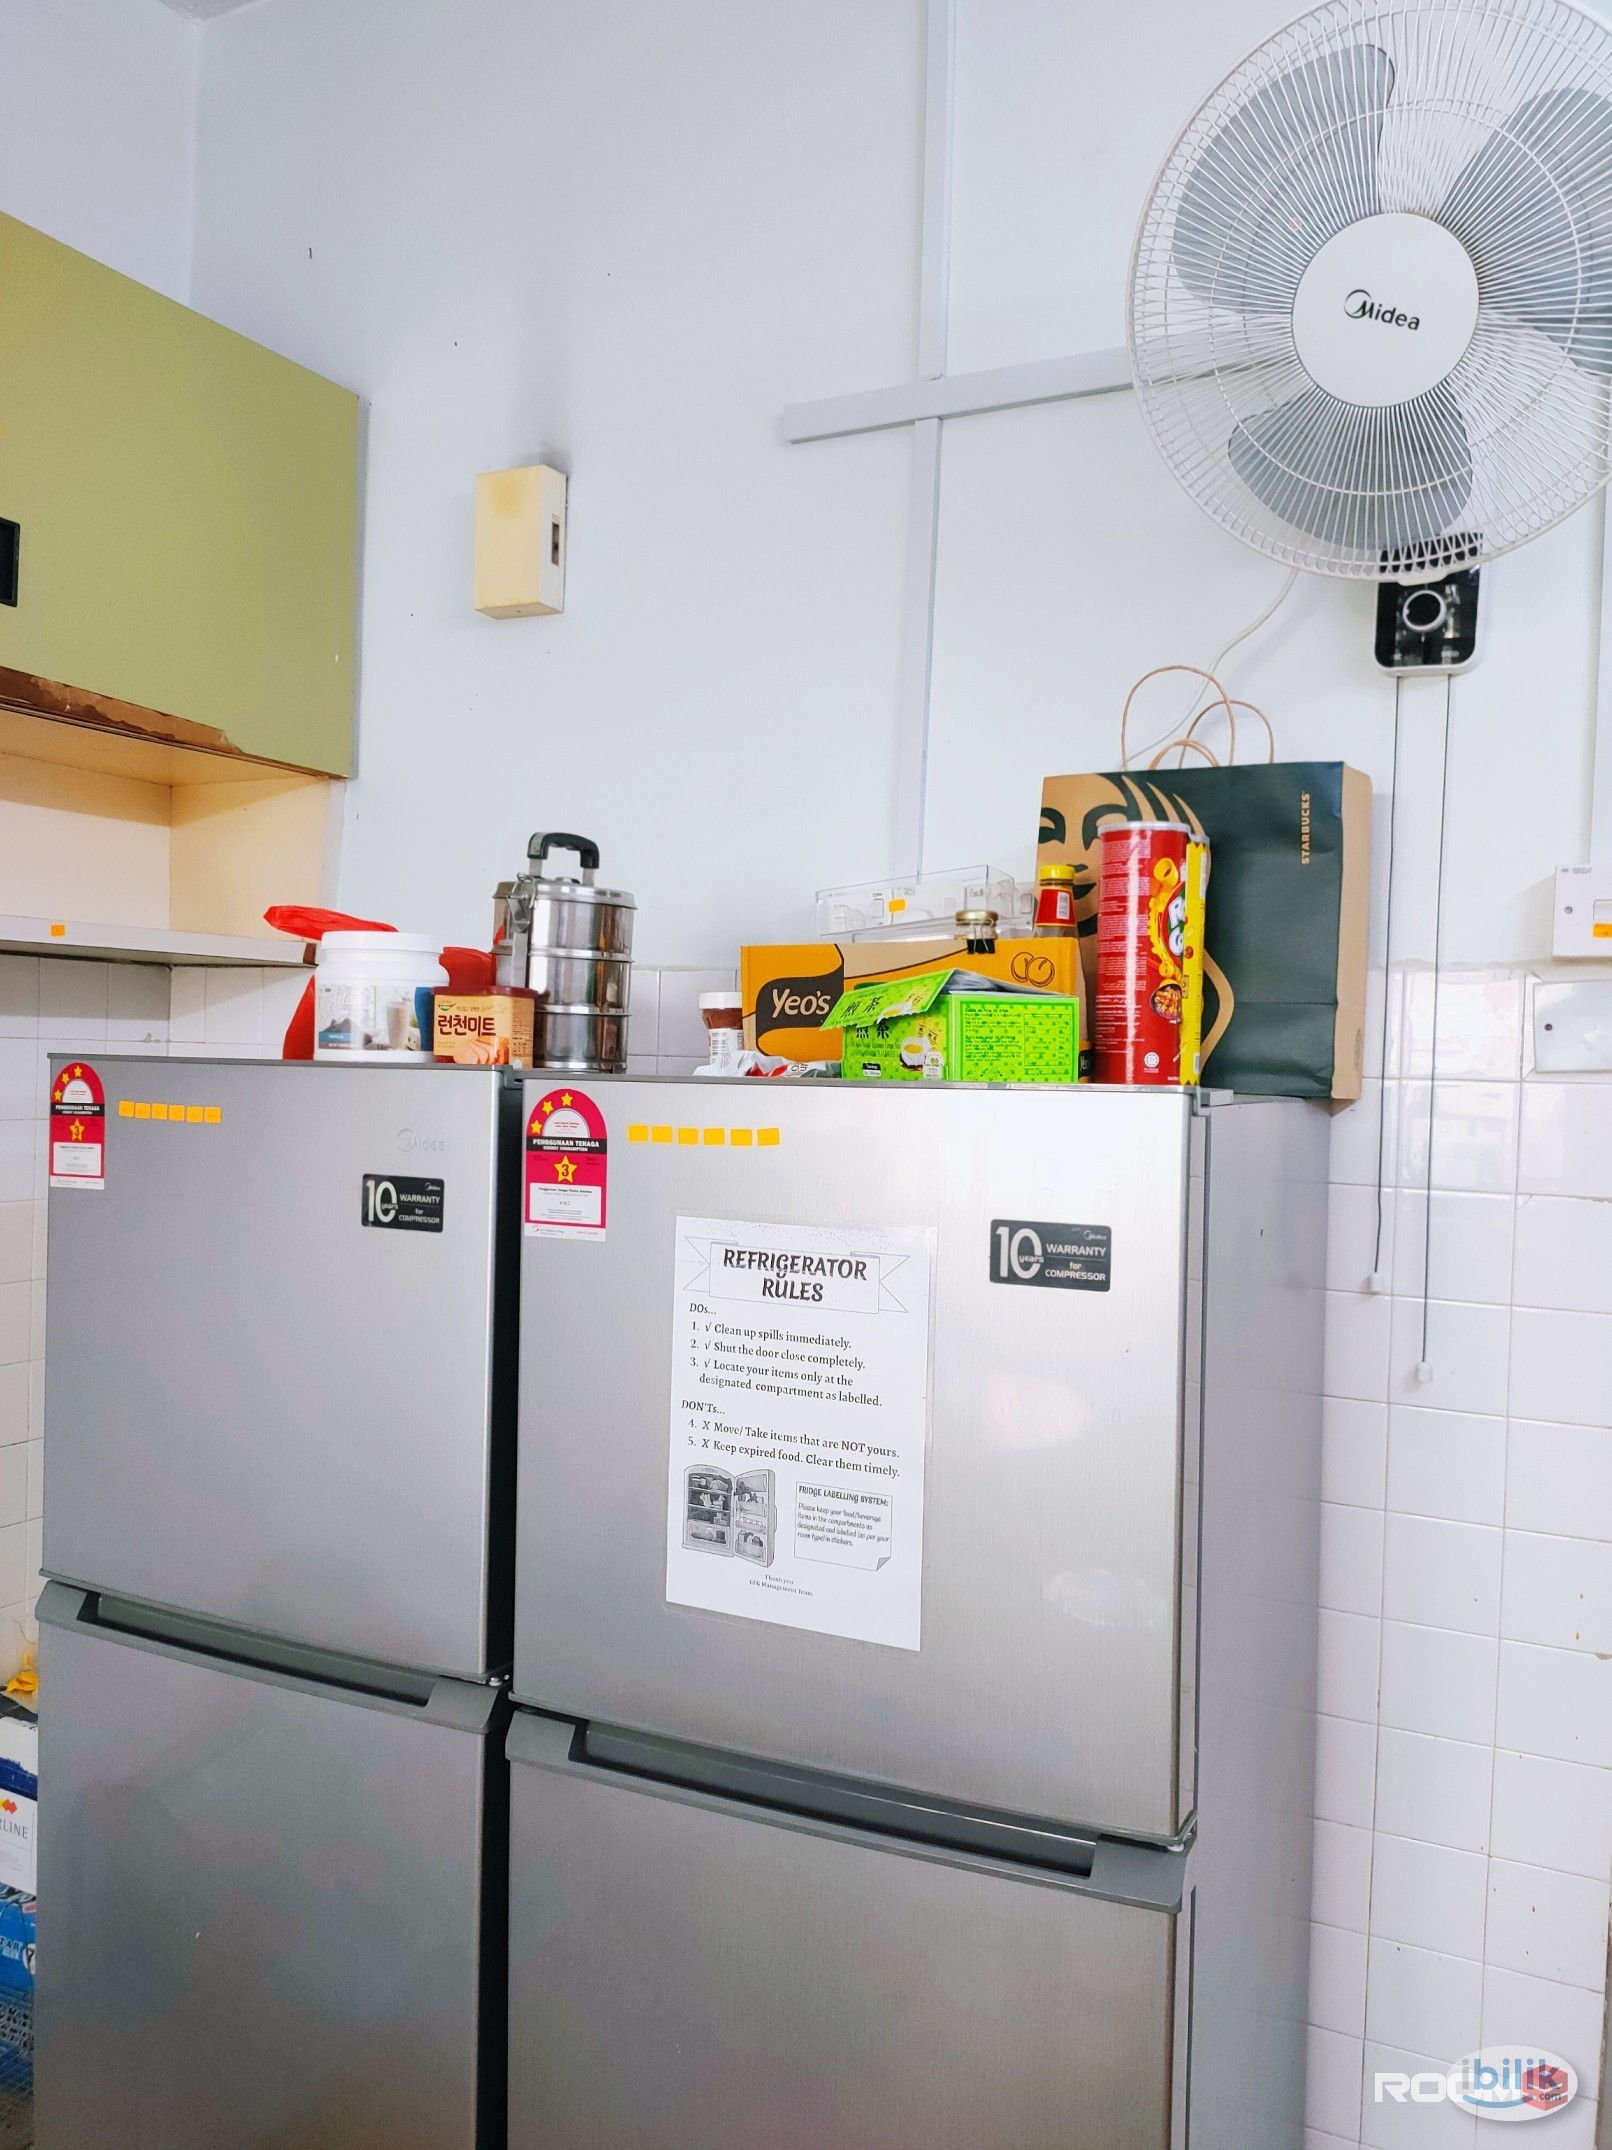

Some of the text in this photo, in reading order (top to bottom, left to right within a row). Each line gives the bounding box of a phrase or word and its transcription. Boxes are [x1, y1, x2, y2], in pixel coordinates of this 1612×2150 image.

[1343, 289, 1421, 331] Midea
[1301, 793, 1310, 865] STARBUCKS
[772, 988, 831, 1018] Yeo's
[437, 1014, 496, 1037] 런천미트
[533, 1139, 600, 1148] PENGGUNAAN TENAGA
[561, 1163, 569, 1177] 3
[366, 1179, 398, 1223] 10
[400, 1194, 440, 1204] WARRANTY
[399, 1215, 440, 1224] COMPRESSOR
[996, 1226, 1043, 1279] 10
[1019, 1255, 1044, 1263] years
[1046, 1243, 1106, 1256] WARRANTY
[723, 1247, 867, 1281] REFRIGERATOR
[1045, 1269, 1106, 1281] COMPRESSOR
[1069, 1262, 1082, 1270] for
[761, 1277, 824, 1302] RULES
[691, 1321, 700, 1331] 1.
[714, 1323, 742, 1336] Clean
[743, 1328, 757, 1340] up
[758, 1328, 784, 1341] spills
[785, 1331, 852, 1350] immediately.
[690, 1340, 700, 1349] 2.
[714, 1341, 737, 1354] Shut
[738, 1344, 754, 1356] the
[755, 1347, 779, 1359] door
[781, 1350, 806, 1362] close
[807, 1353, 866, 1371] completely.
[690, 1357, 699, 1367] 3.
[713, 1359, 745, 1373] Locate
[746, 1365, 770, 1378] your
[771, 1366, 799, 1379] items
[800, 1370, 823, 1386] only
[824, 1373, 835, 1384] at
[836, 1374, 854, 1386] the
[699, 1373, 883, 1407] designated compartment as labelled.
[688, 1419, 697, 1429] 4.
[701, 1421, 711, 1431] X
[744, 1427, 769, 1439] Take
[770, 1430, 798, 1443] items
[800, 1434, 820, 1447] that
[822, 1439, 839, 1449] are
[841, 1440, 866, 1453] NOT
[866, 1445, 900, 1459] yours.
[687, 1437, 901, 1479] 5. X Keep expired food. Clear them timely.
[799, 1485, 889, 1507] FRIDGE LABELLING SYSTEM:
[798, 1502, 816, 1512] Please
[816, 1505, 829, 1515] keep
[797, 1521, 825, 1532] designated
[876, 1535, 890, 1543] your
[818, 1515, 827, 1523] the
[828, 1518, 865, 1529] compartments
[797, 1531, 811, 1539] room
[761, 1581, 797, 1593] Management
[798, 1588, 813, 1596] Team
[0, 1818, 28, 1840] LINE
